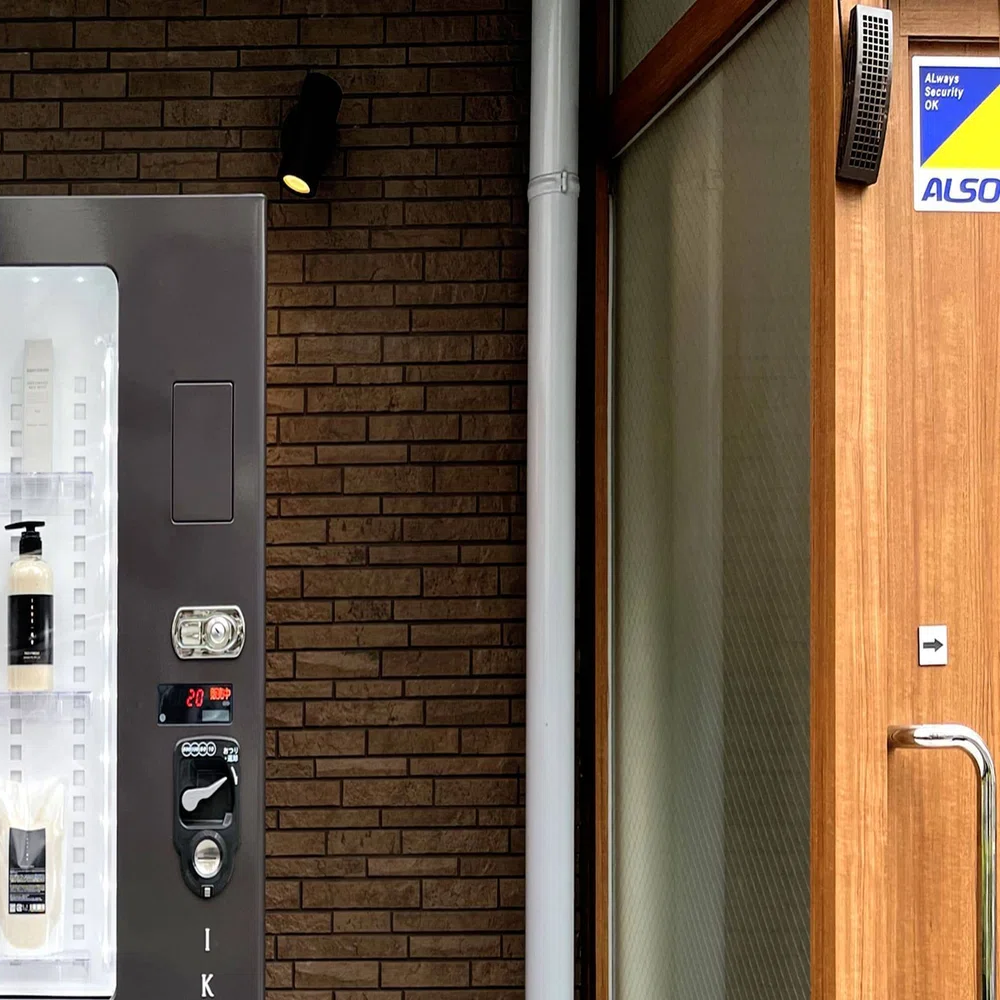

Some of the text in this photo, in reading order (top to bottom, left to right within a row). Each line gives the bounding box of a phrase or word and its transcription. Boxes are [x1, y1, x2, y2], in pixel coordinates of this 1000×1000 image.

[924, 72, 960, 85] ALways
[924, 86, 964, 100] Security
[924, 99, 939, 111] OK
[921, 177, 1000, 204] ALSO
[186, 688, 204, 707] 20
